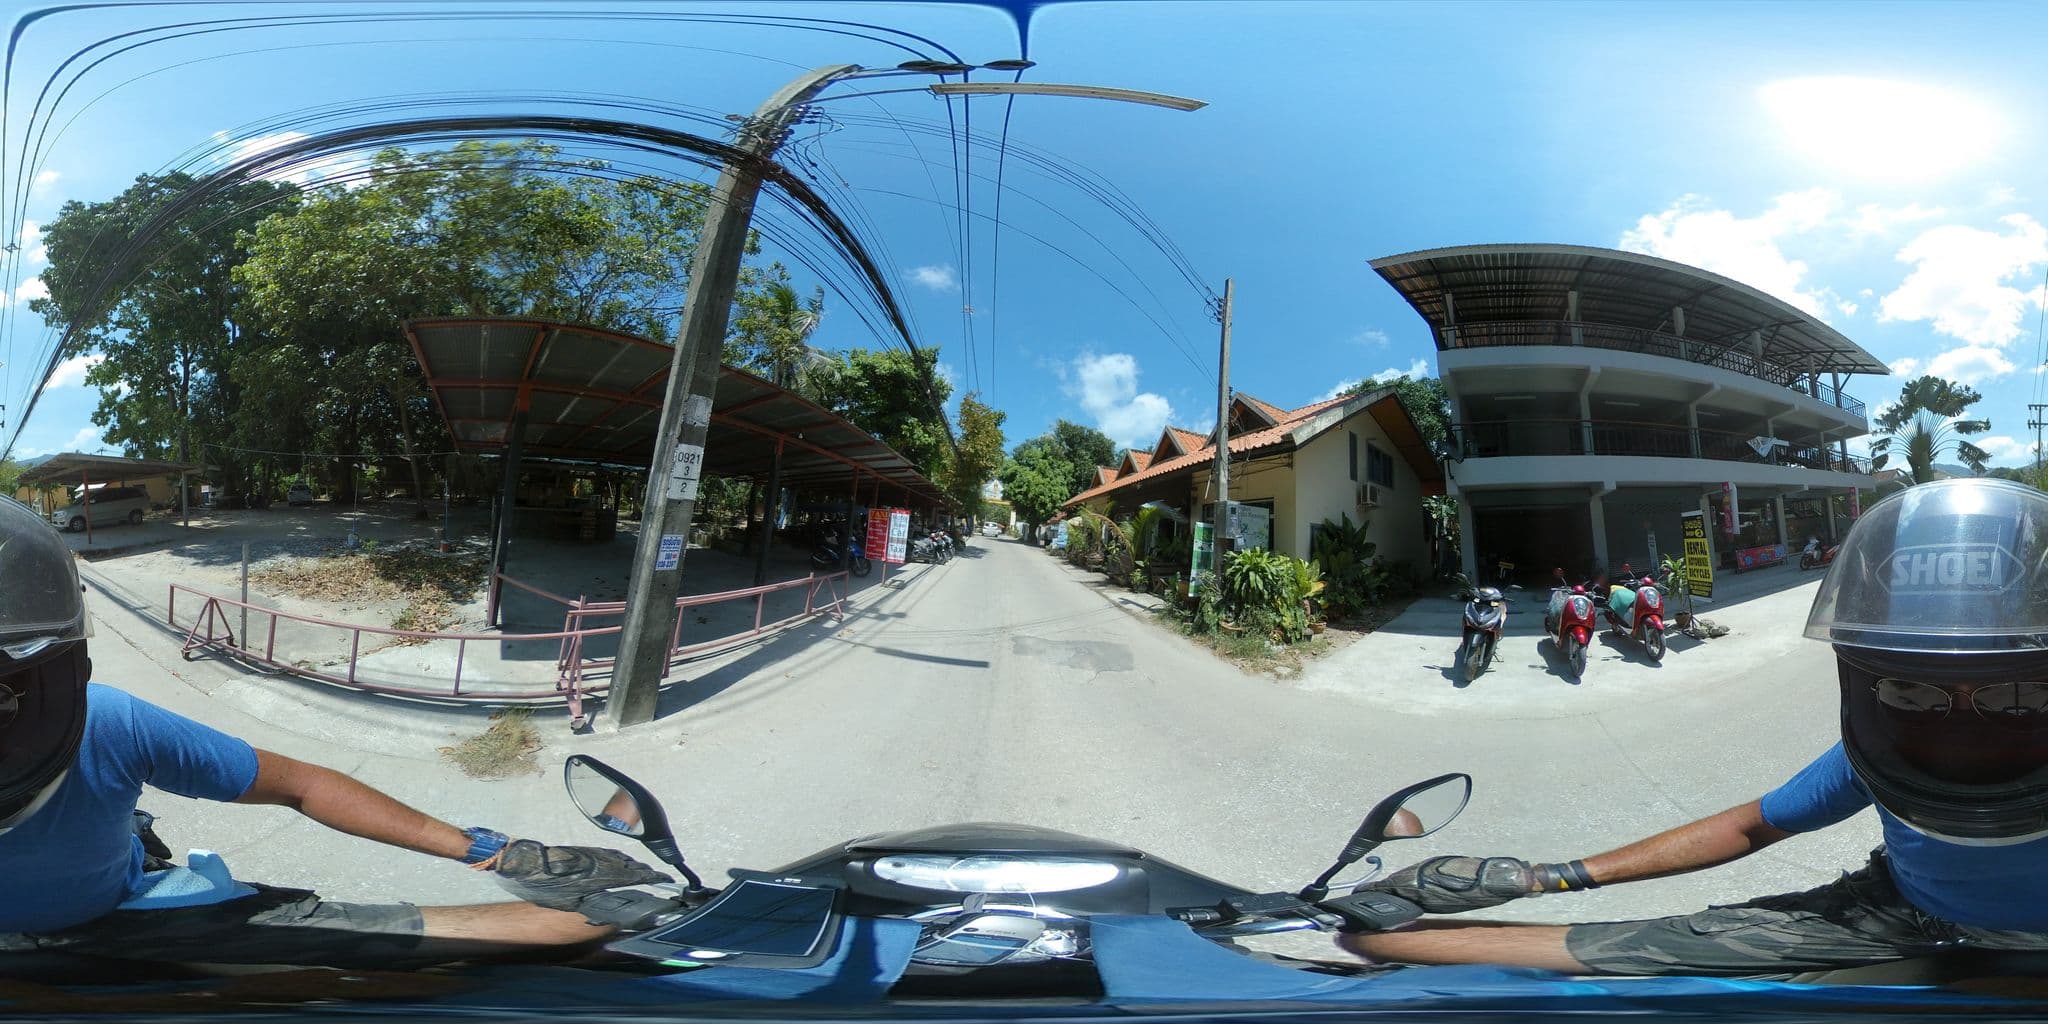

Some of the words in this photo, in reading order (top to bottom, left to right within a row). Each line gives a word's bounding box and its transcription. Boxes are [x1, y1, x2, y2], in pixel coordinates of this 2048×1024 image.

[678, 452, 700, 464] 0921
[684, 466, 690, 476] 3
[680, 482, 688, 493] 2
[889, 544, 905, 553] Taxi
[1686, 541, 1708, 556] RENTAL
[1891, 551, 2002, 586] SHOEI
